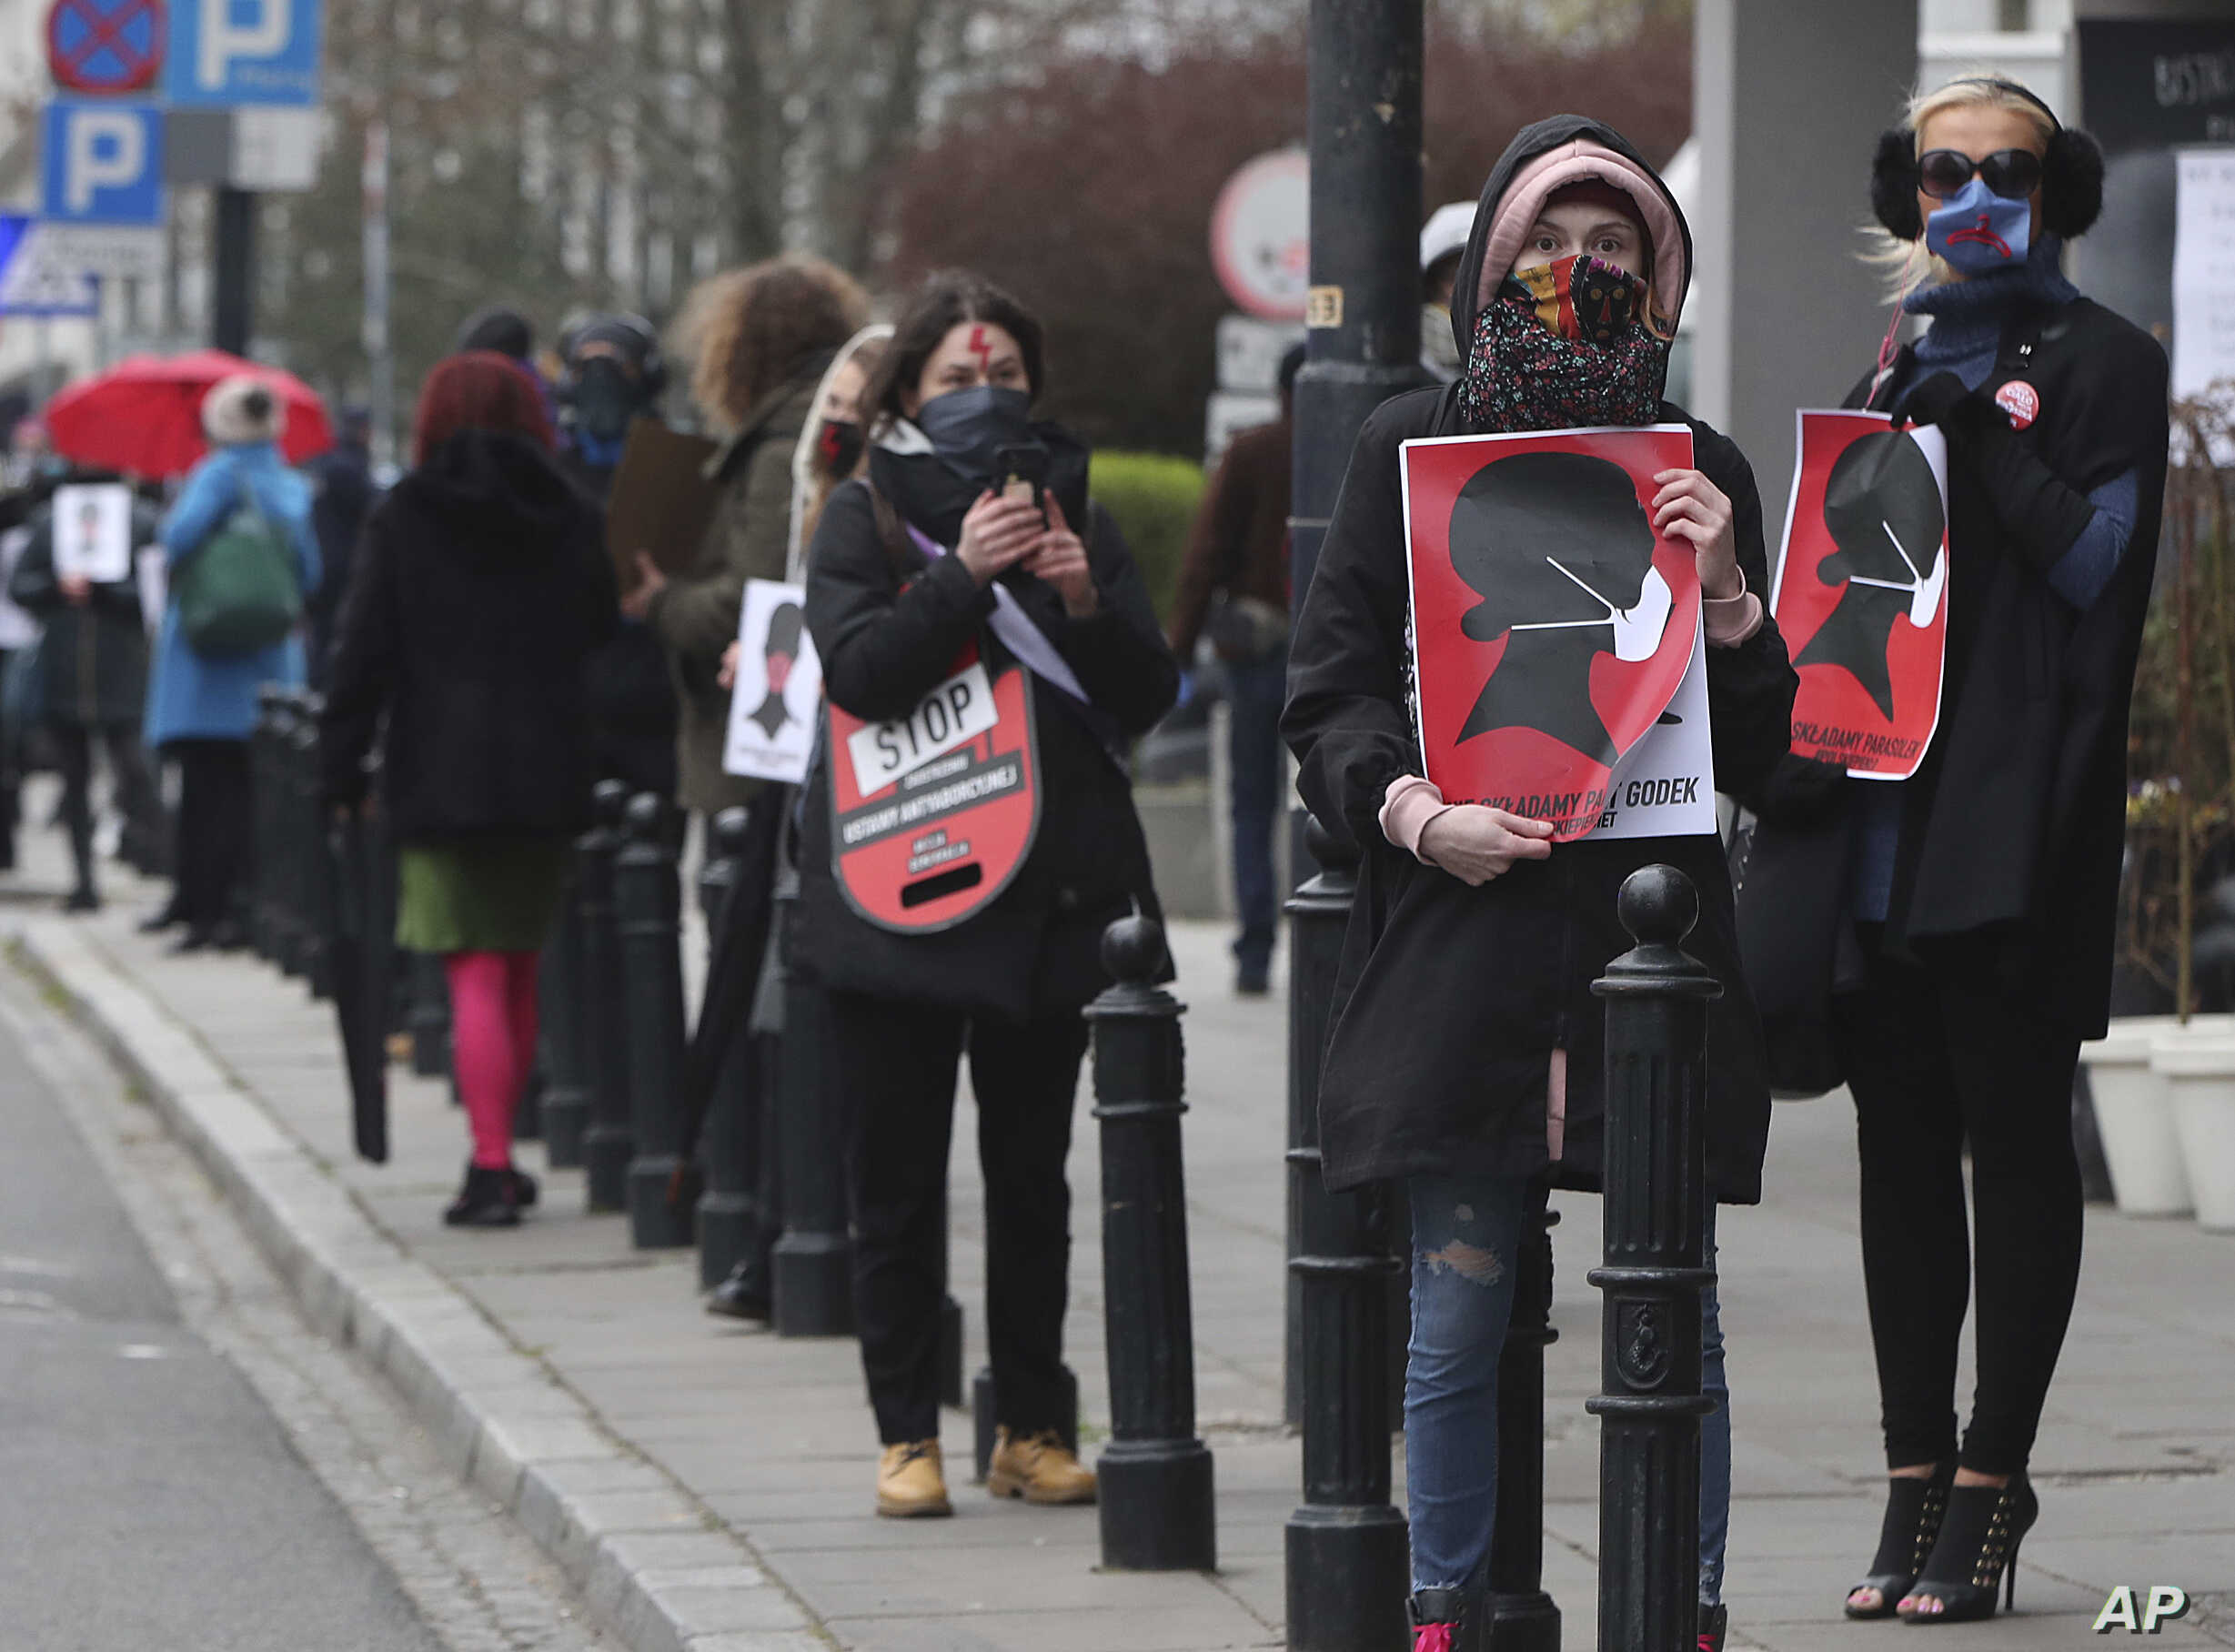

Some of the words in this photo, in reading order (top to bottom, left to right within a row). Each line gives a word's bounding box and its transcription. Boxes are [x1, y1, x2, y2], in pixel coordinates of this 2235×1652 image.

[196, 0, 293, 87] P
[65, 110, 146, 213] P
[876, 683, 972, 771] STOP
[1625, 777, 1700, 808] GODEK
